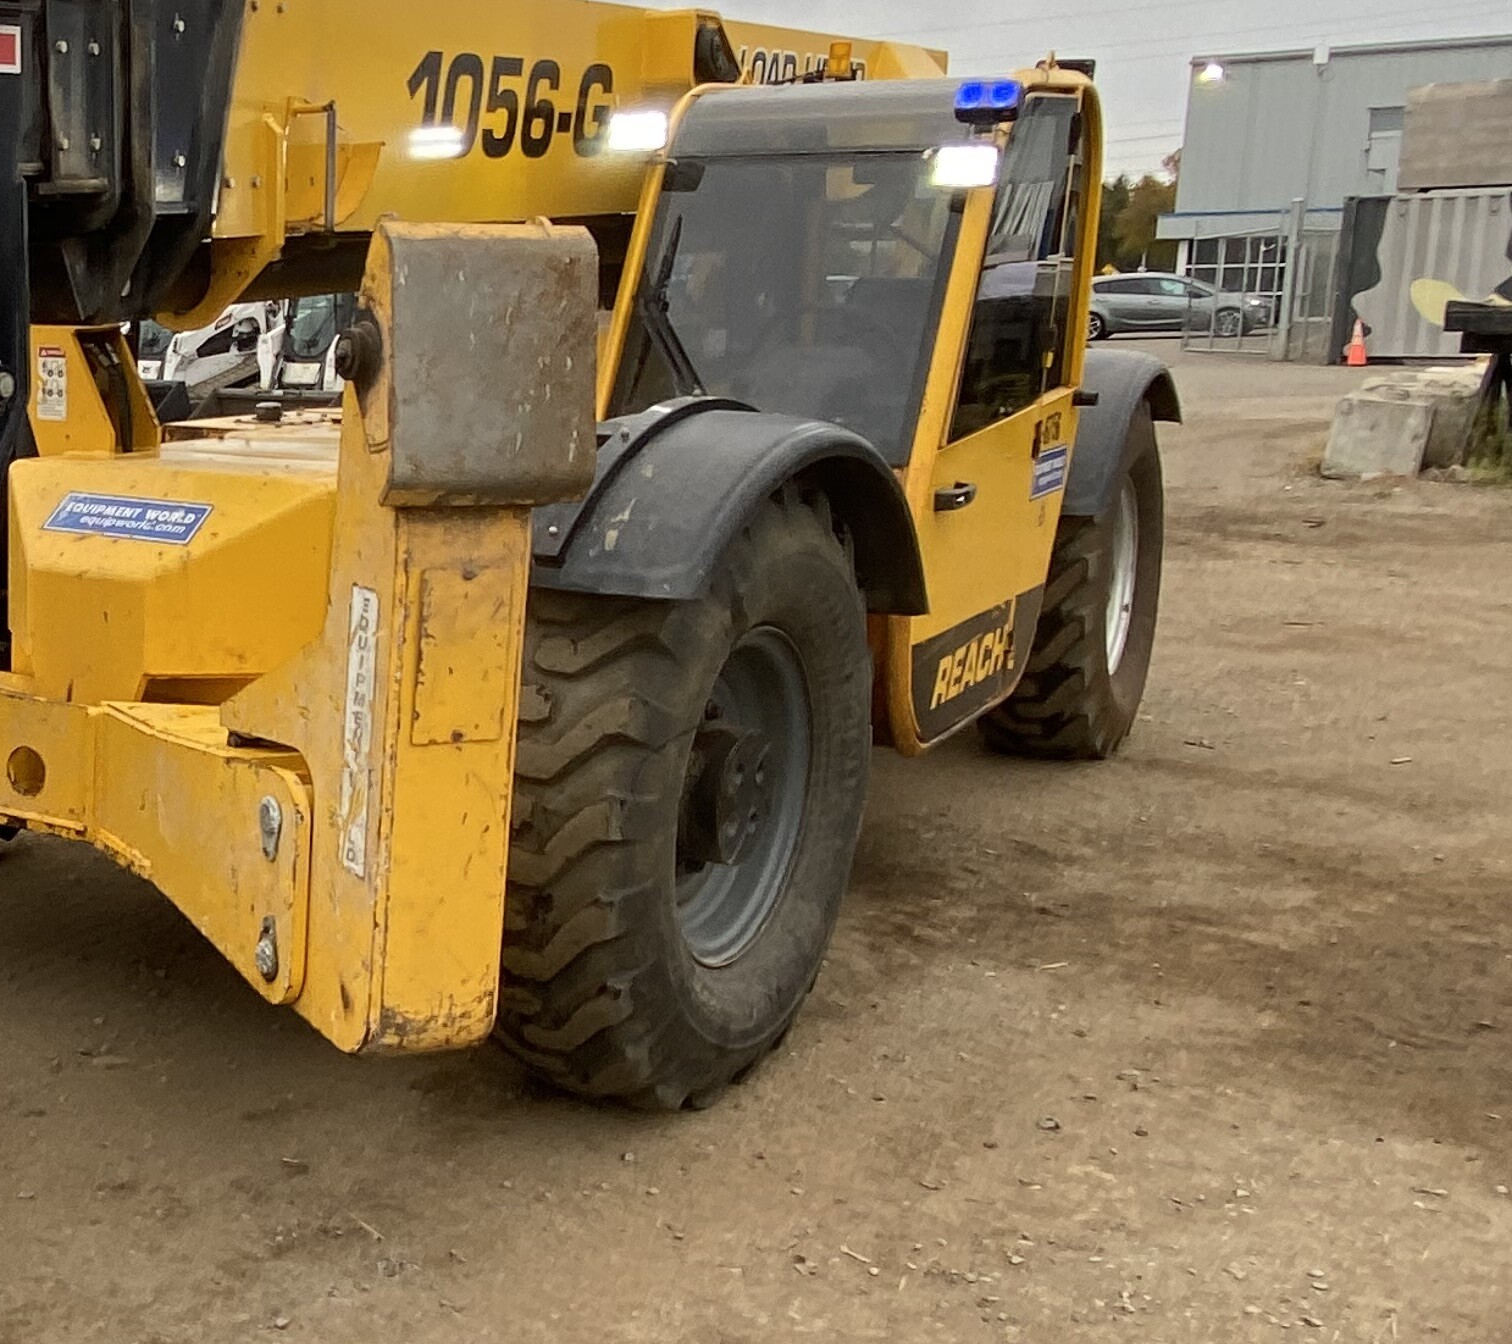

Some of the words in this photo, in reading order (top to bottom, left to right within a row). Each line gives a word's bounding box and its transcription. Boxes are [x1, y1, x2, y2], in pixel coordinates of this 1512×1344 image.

[406, 50, 614, 159] 1056-G
[65, 501, 143, 519] EQUIPMENT
[144, 508, 196, 525] WORLD
